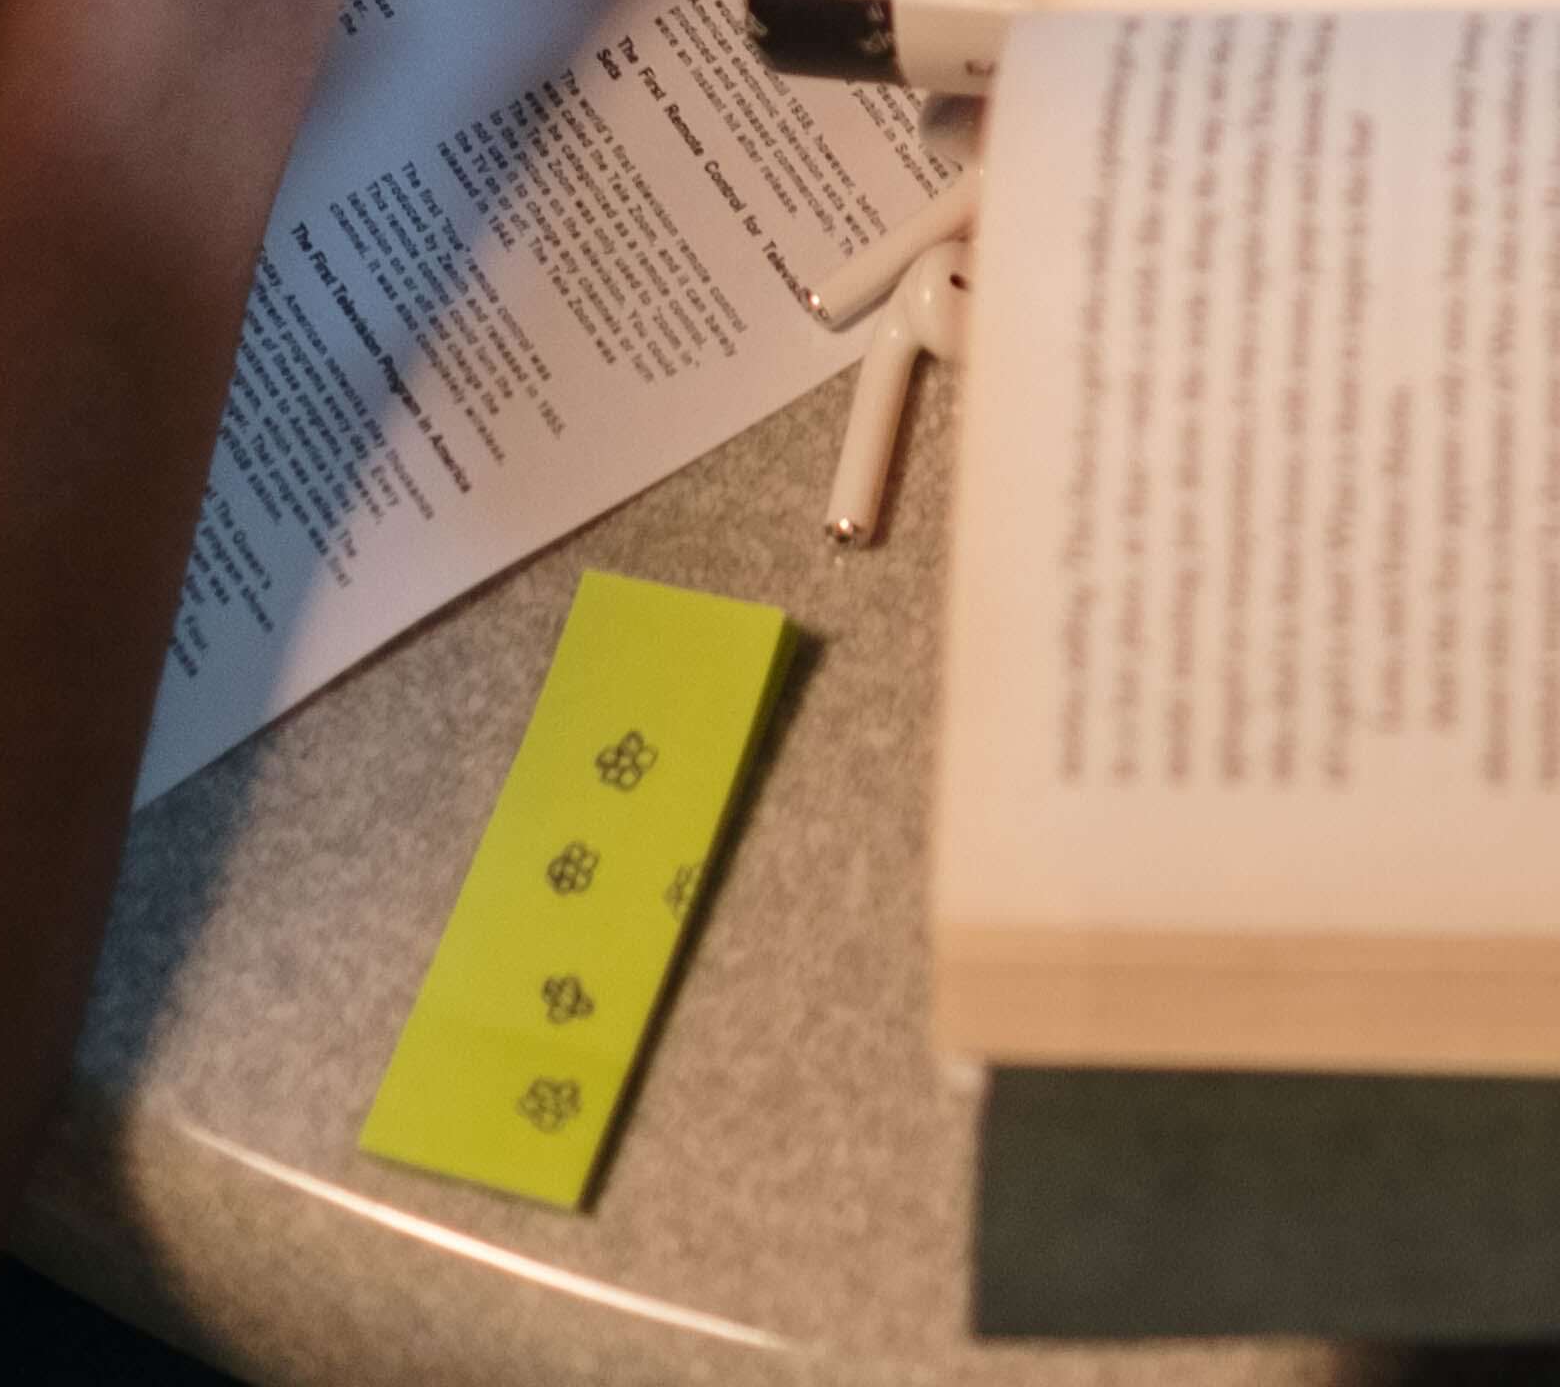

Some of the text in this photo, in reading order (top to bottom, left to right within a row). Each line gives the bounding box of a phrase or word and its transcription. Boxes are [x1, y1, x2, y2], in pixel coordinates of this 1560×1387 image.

[595, 47, 622, 81] Sets
[617, 34, 639, 65] The
[637, 65, 667, 102] First
[663, 102, 705, 157] Remote
[703, 159, 747, 213] Control
[741, 214, 763, 237] for
[290, 221, 472, 494] The First Television Program in America
